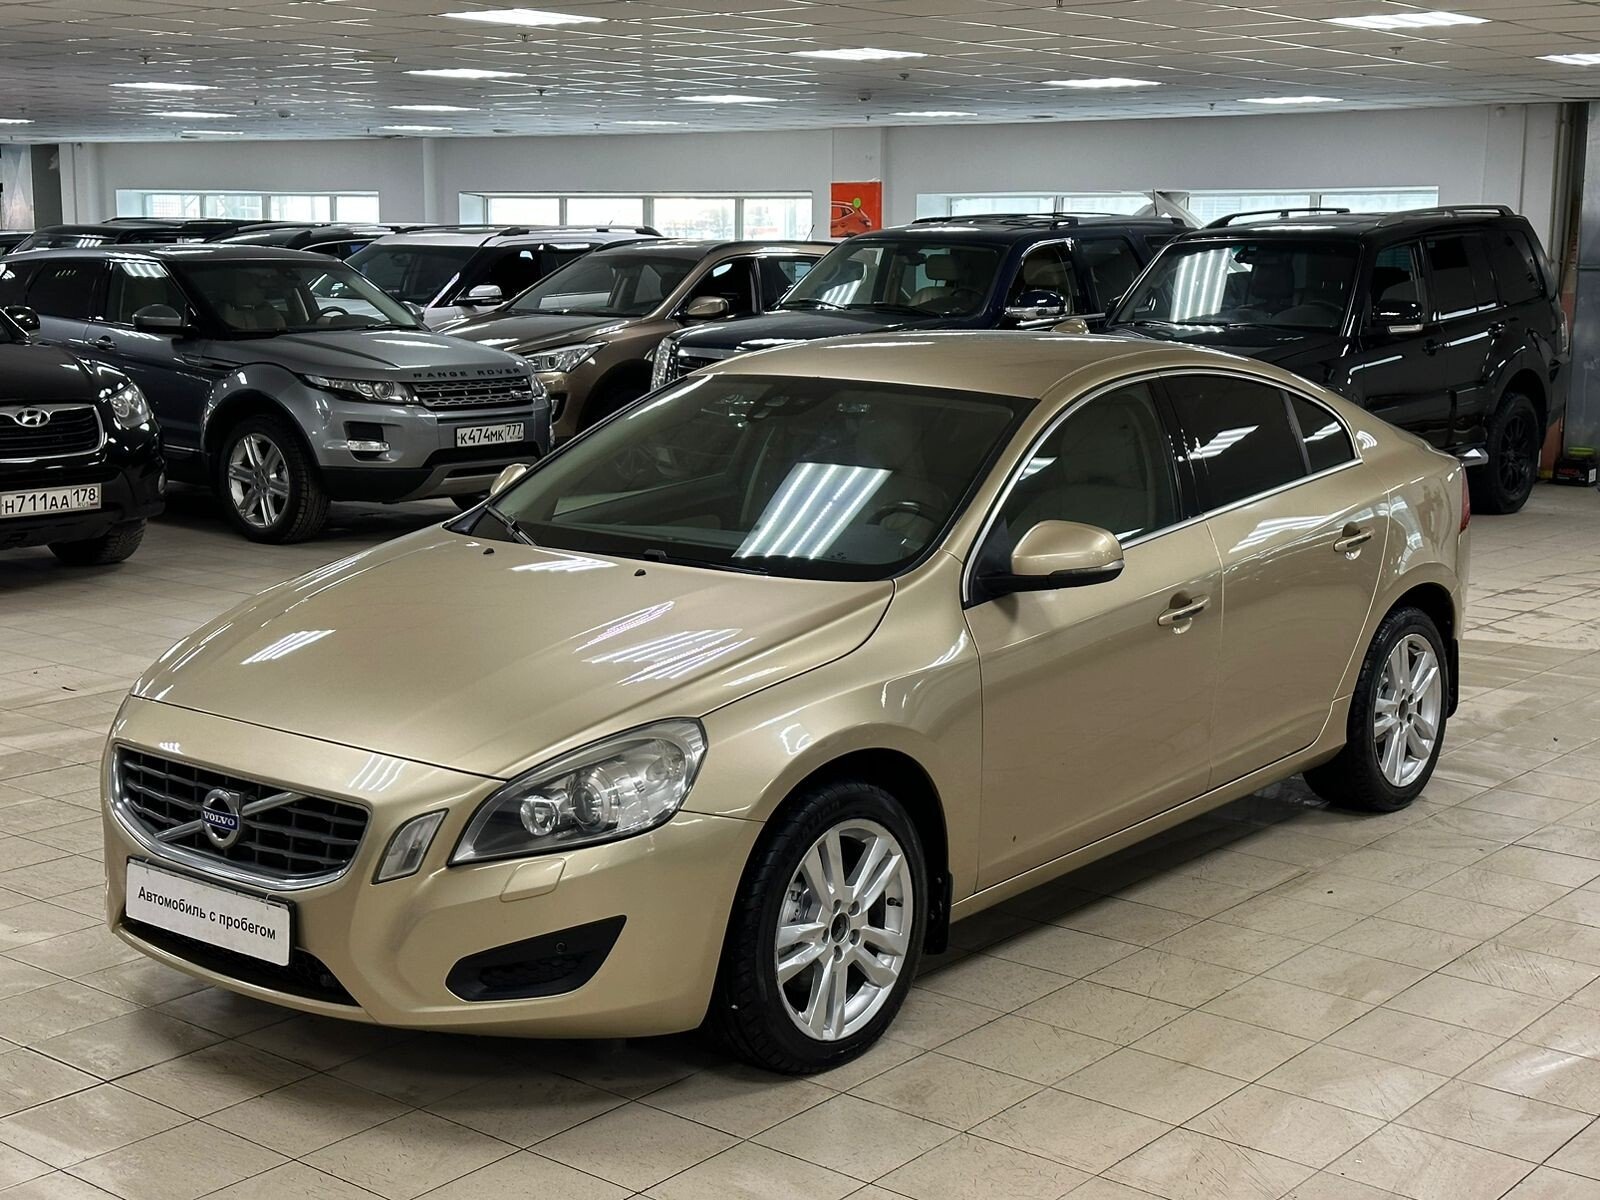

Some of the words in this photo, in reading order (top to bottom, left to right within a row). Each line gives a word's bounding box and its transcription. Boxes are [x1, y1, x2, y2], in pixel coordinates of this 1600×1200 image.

[413, 370, 468, 378] RANGE
[476, 367, 521, 376] ROVER
[73, 488, 96, 502] 178
[203, 810, 235, 826] VOLVO
[138, 886, 206, 919] Автомобиль
[209, 911, 216, 922] с
[219, 914, 276, 940] пробегом
